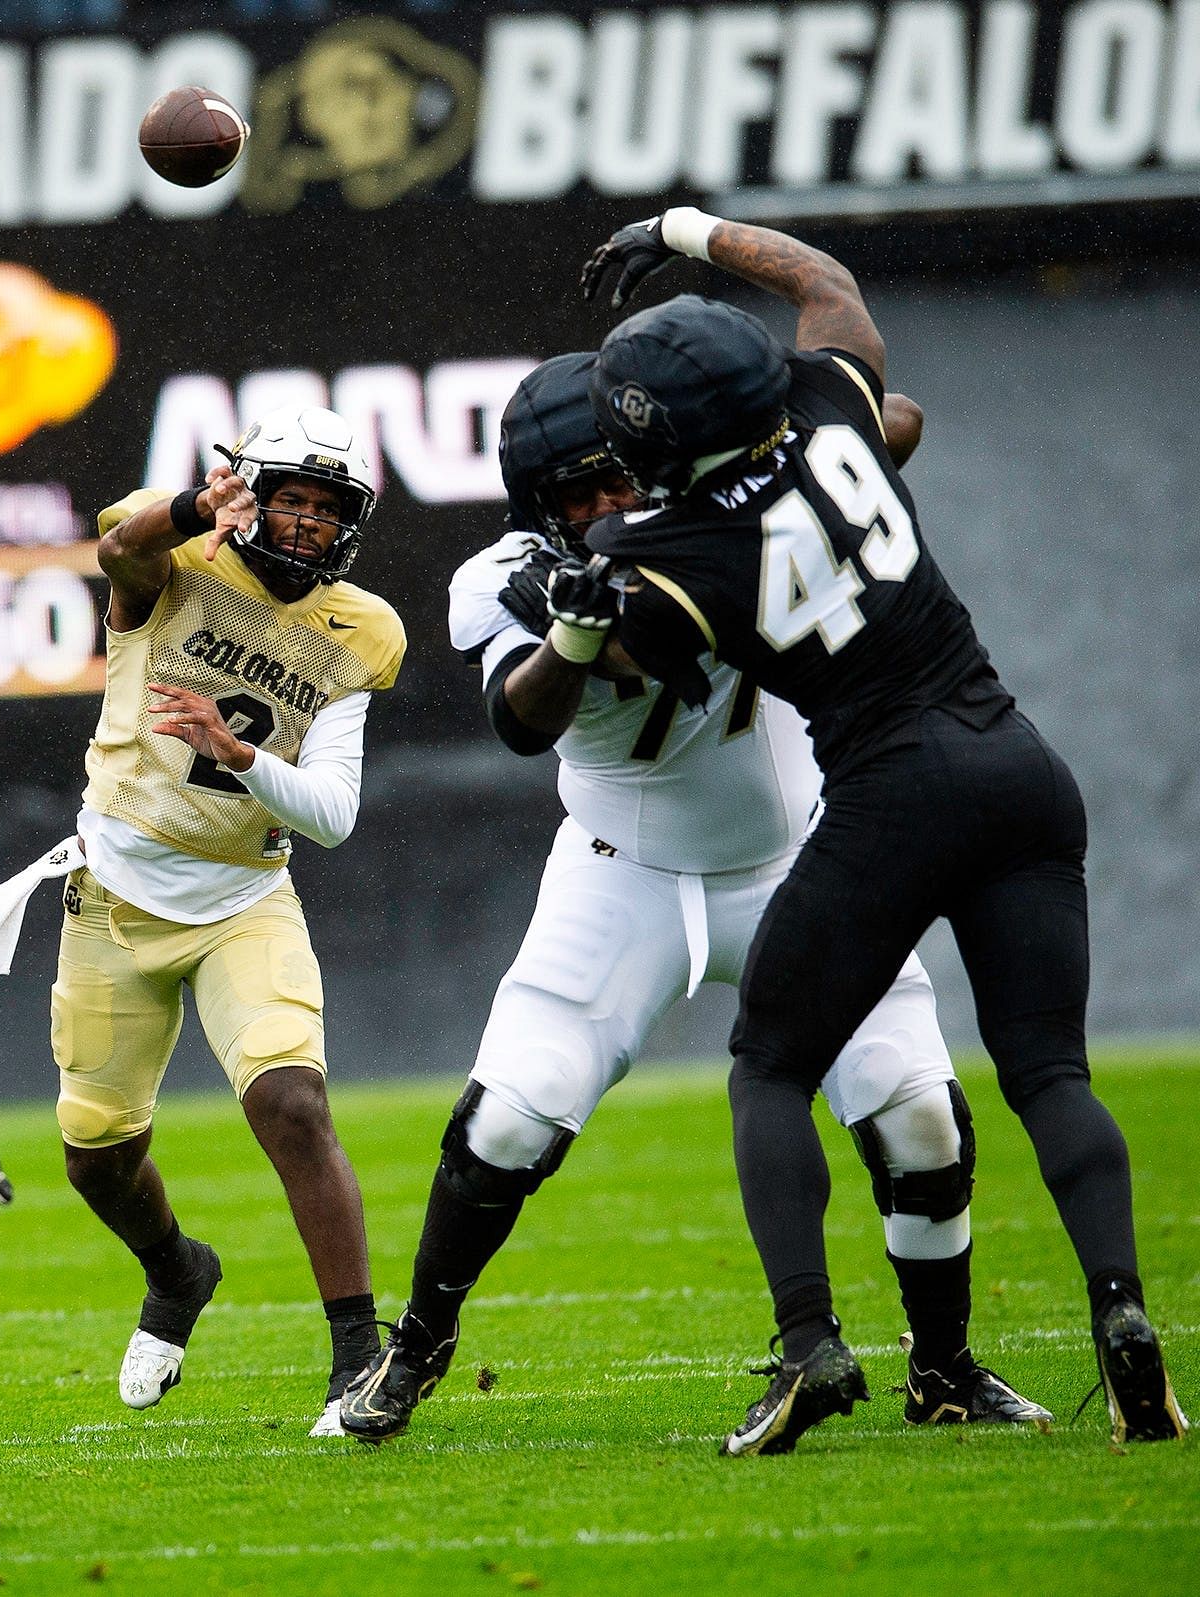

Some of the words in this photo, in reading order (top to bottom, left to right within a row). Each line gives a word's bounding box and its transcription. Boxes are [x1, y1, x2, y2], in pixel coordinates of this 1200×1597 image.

[315, 455, 340, 469] BUFFS
[756, 424, 920, 656] 49
[180, 687, 282, 801] 2
